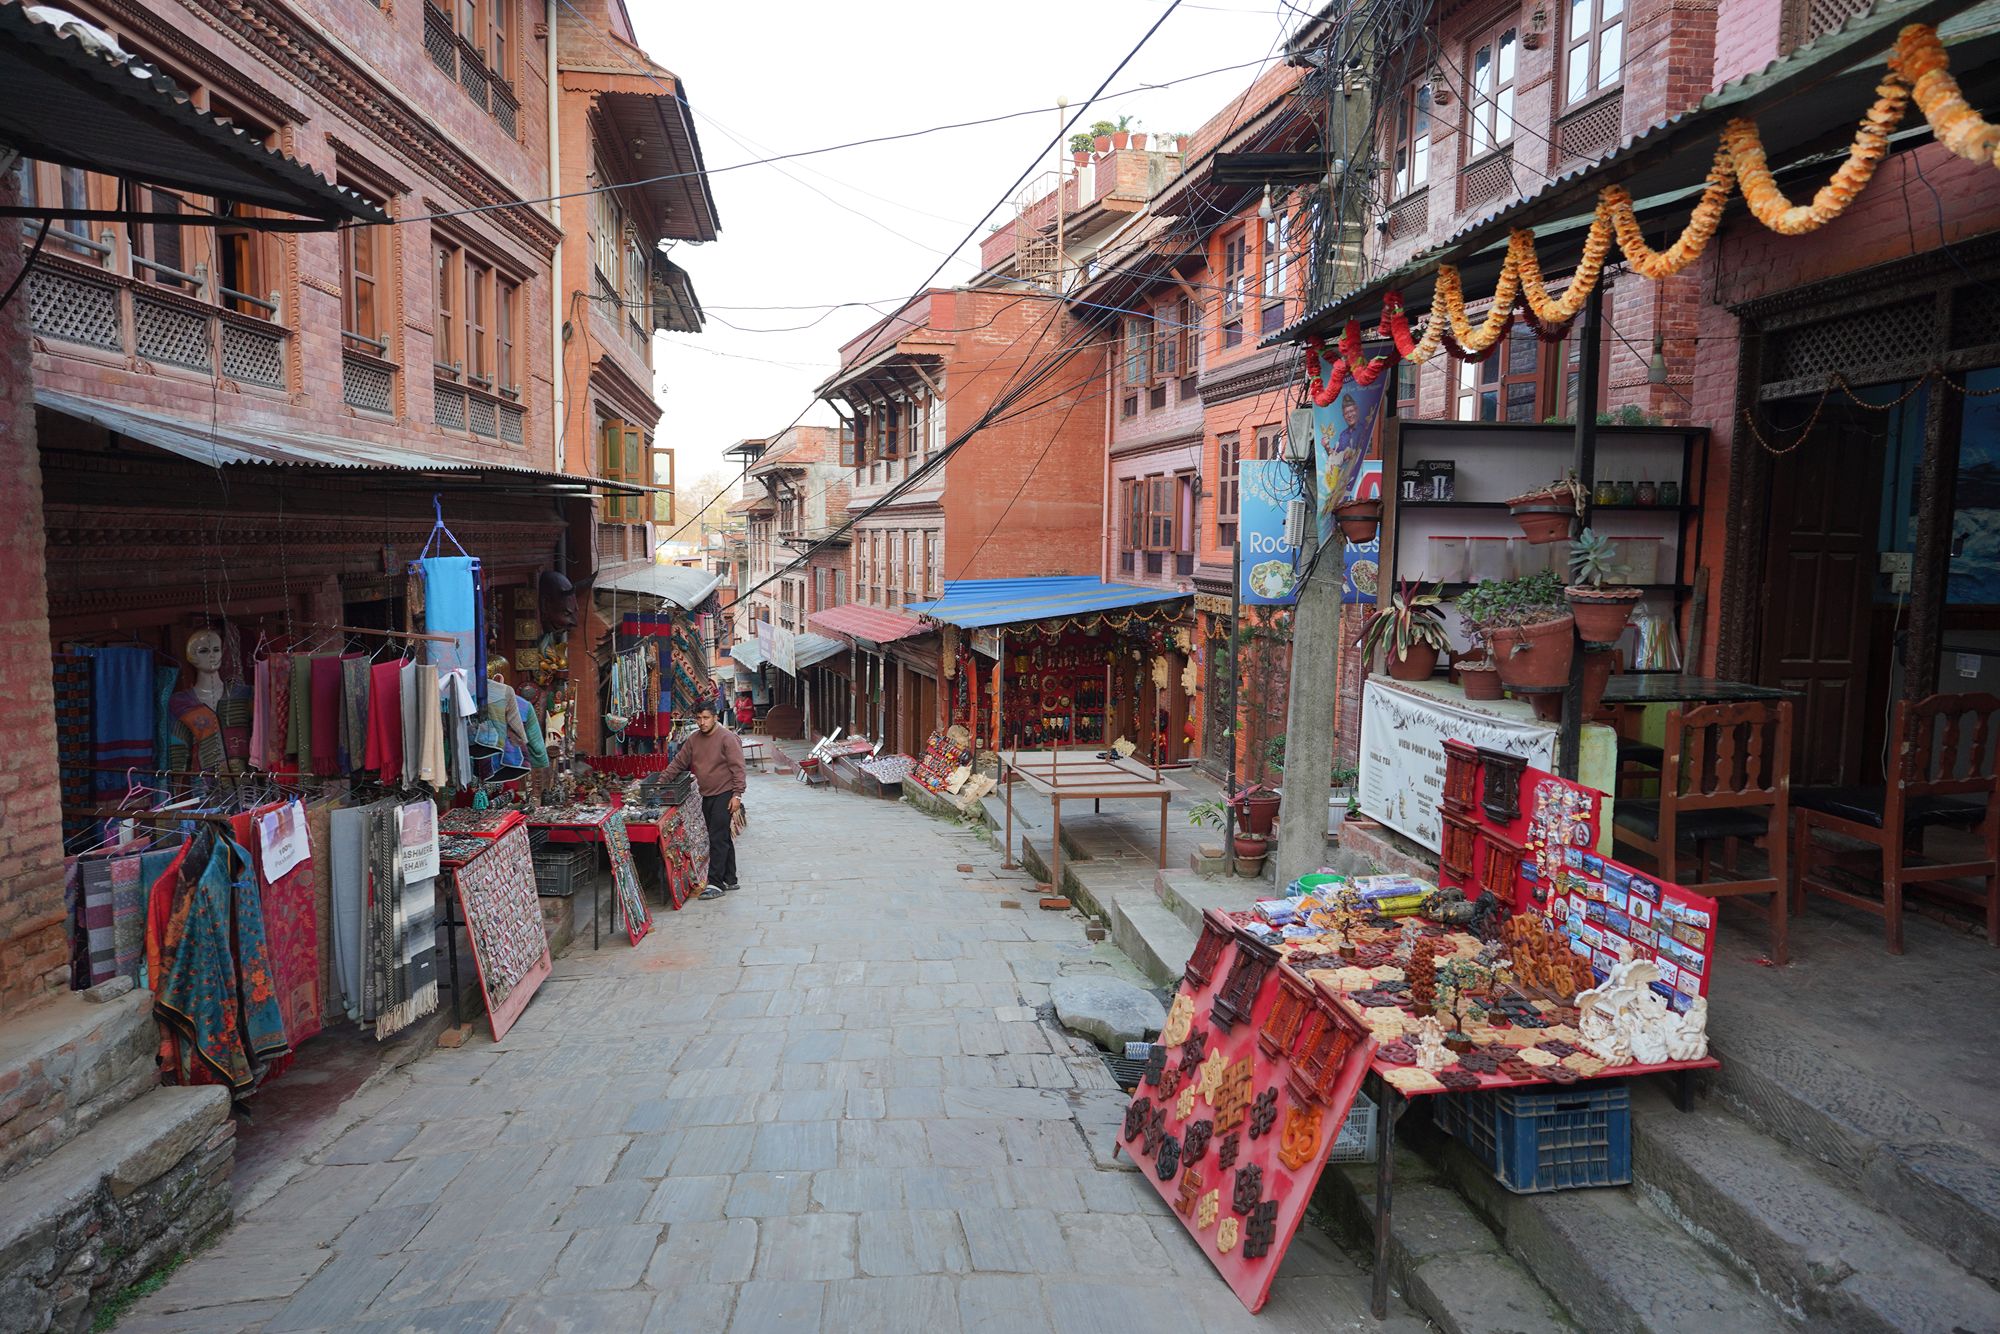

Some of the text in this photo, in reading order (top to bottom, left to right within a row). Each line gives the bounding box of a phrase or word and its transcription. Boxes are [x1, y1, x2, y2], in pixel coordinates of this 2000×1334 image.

[1250, 531, 1293, 554] Roo
[1412, 742, 1426, 756] POINT
[403, 844, 433, 860] ASHMERE
[404, 859, 428, 872] SHAWL
